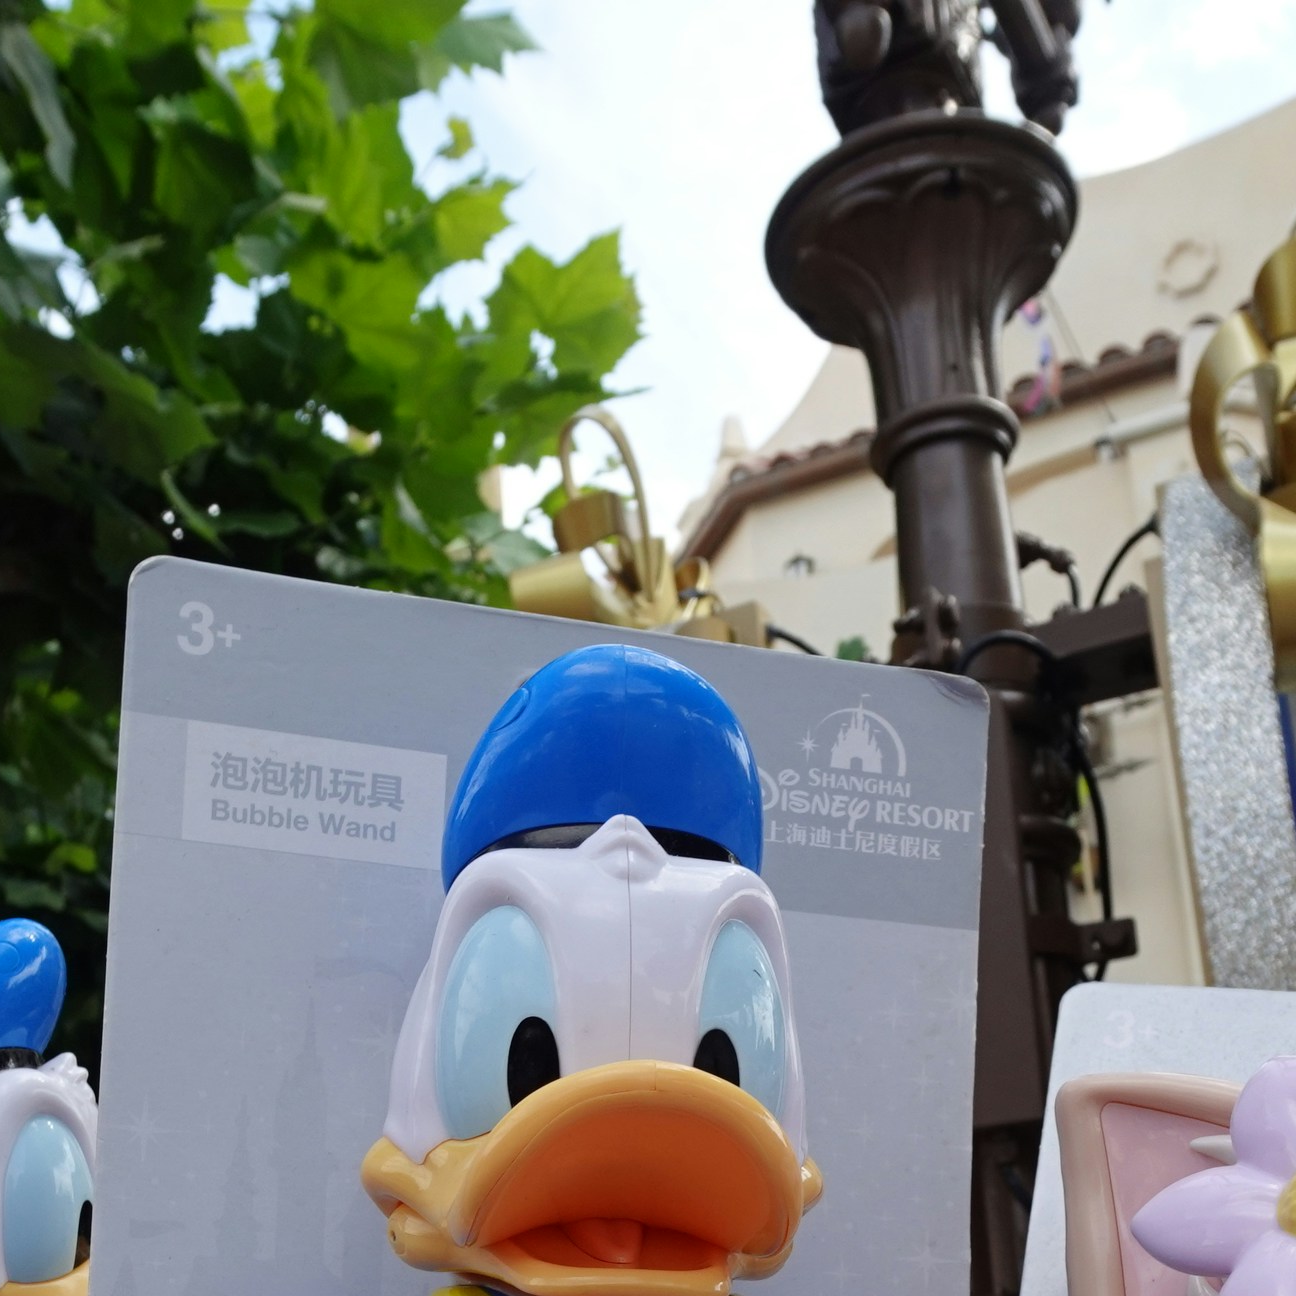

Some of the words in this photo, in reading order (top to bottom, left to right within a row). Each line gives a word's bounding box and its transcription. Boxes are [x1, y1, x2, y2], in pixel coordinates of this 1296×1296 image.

[177, 601, 241, 655] 3+
[210, 751, 405, 812] 泡泡机玩具
[808, 767, 911, 798] SHANGHAI
[210, 798, 309, 832] Bubble
[318, 811, 396, 842] Wand
[875, 800, 974, 832] RESORT
[764, 820, 942, 860] 上海迪士尼度假区
